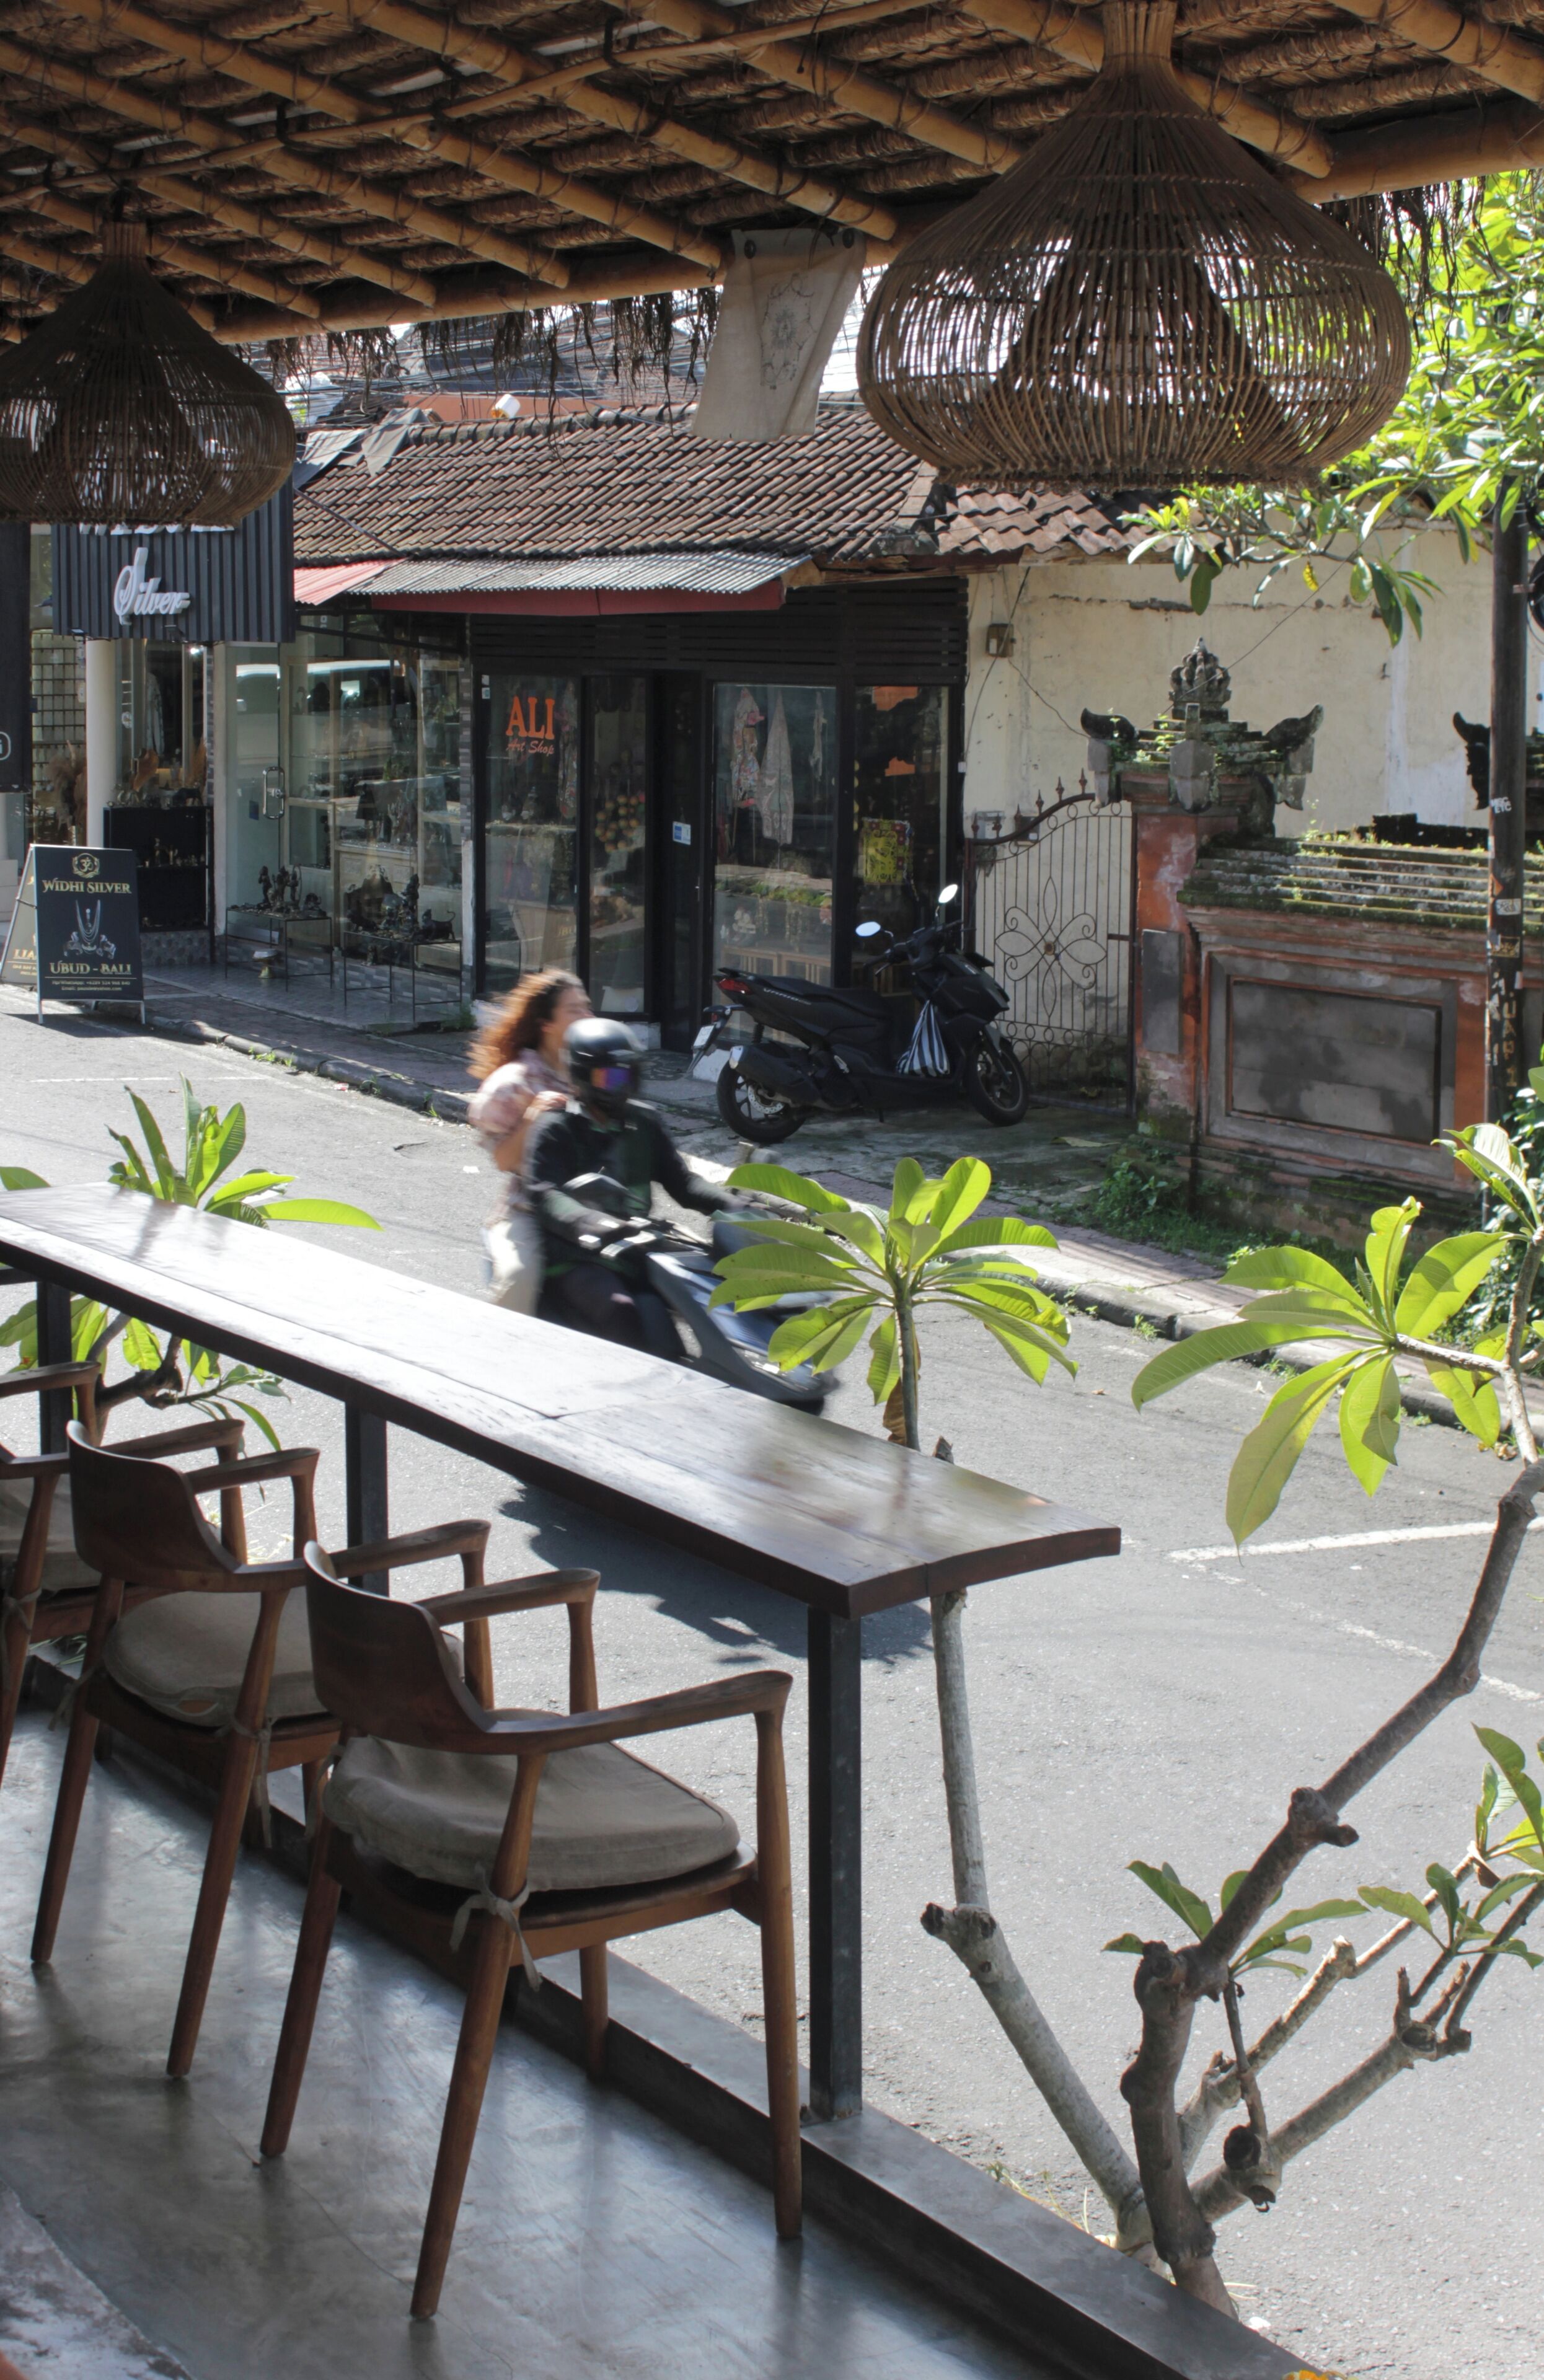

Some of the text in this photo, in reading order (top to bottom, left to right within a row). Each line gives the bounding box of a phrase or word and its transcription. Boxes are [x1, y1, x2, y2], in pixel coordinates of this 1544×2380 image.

[114, 547, 190, 625] Silver
[506, 695, 555, 740] ALI
[506, 738, 555, 756] Art Shop
[42, 878, 132, 894] WIDHI SILVER
[50, 960, 90, 974] UBUD
[100, 963, 132, 975] BALI
